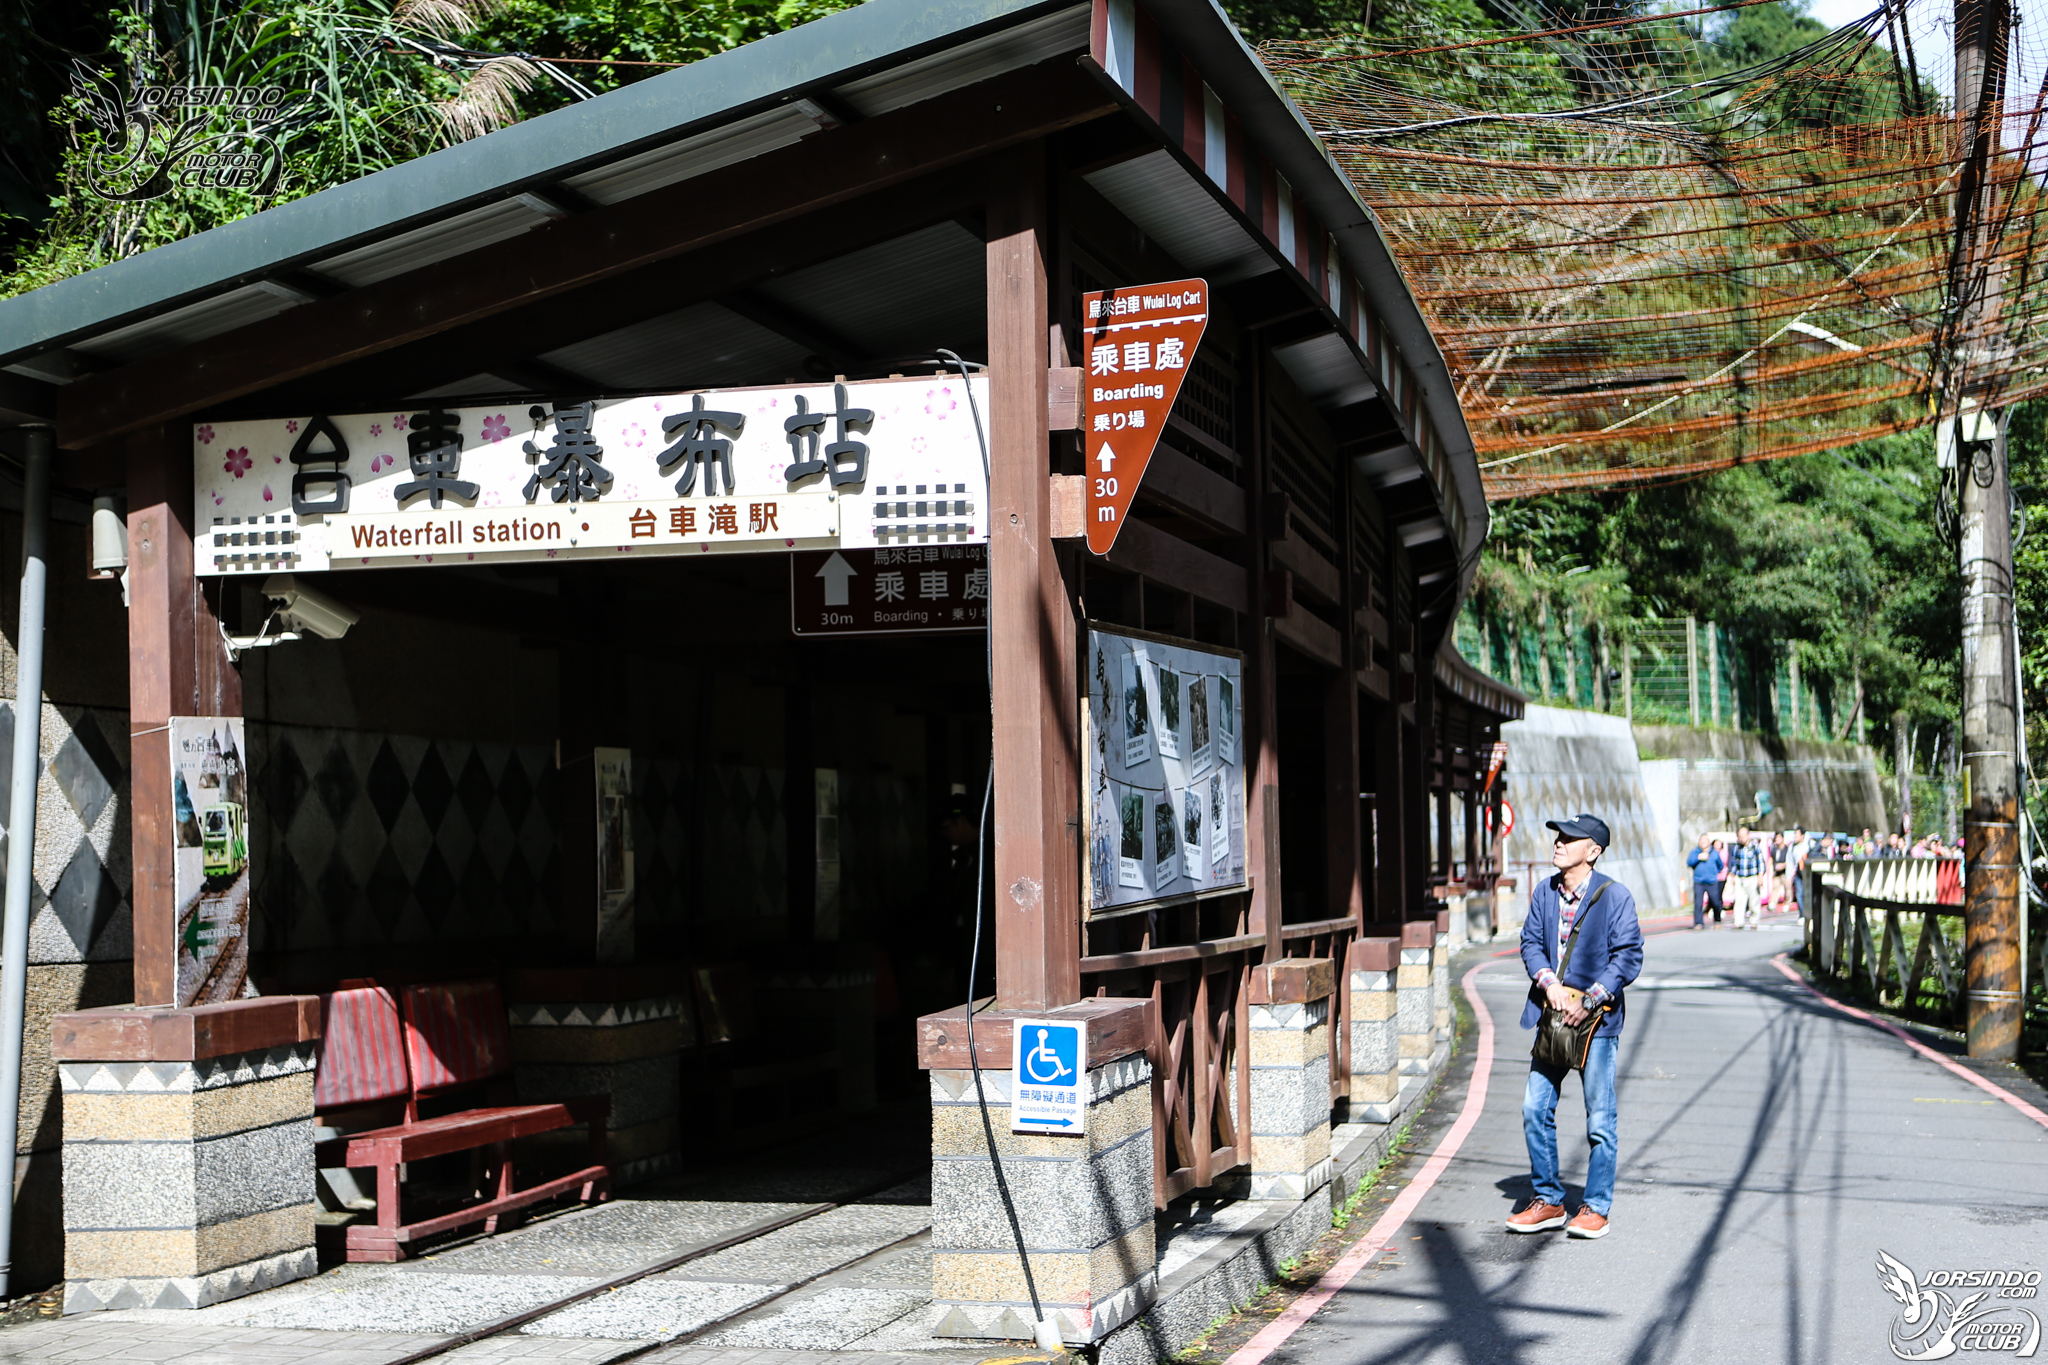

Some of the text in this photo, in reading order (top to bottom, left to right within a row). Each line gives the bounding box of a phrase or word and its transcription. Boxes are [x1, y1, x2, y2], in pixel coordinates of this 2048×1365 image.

[1088, 290, 1201, 319] 烏來台車 Wulai Log Cart
[1091, 337, 1185, 376] 乘車處
[1093, 383, 1164, 402] Boarding
[1093, 409, 1145, 432] 乗り場
[289, 383, 874, 516] 台車瀑布站
[1095, 477, 1118, 498] 30
[628, 502, 779, 538] 台車滝駅
[1098, 505, 1115, 522] m
[351, 518, 561, 549] Waterfall station
[942, 546, 963, 559] Wulai
[965, 545, 980, 561] Log
[821, 612, 854, 625] 30m
[874, 610, 928, 623] Boarding
[1019, 1105, 1076, 1116] Accessible Passage
